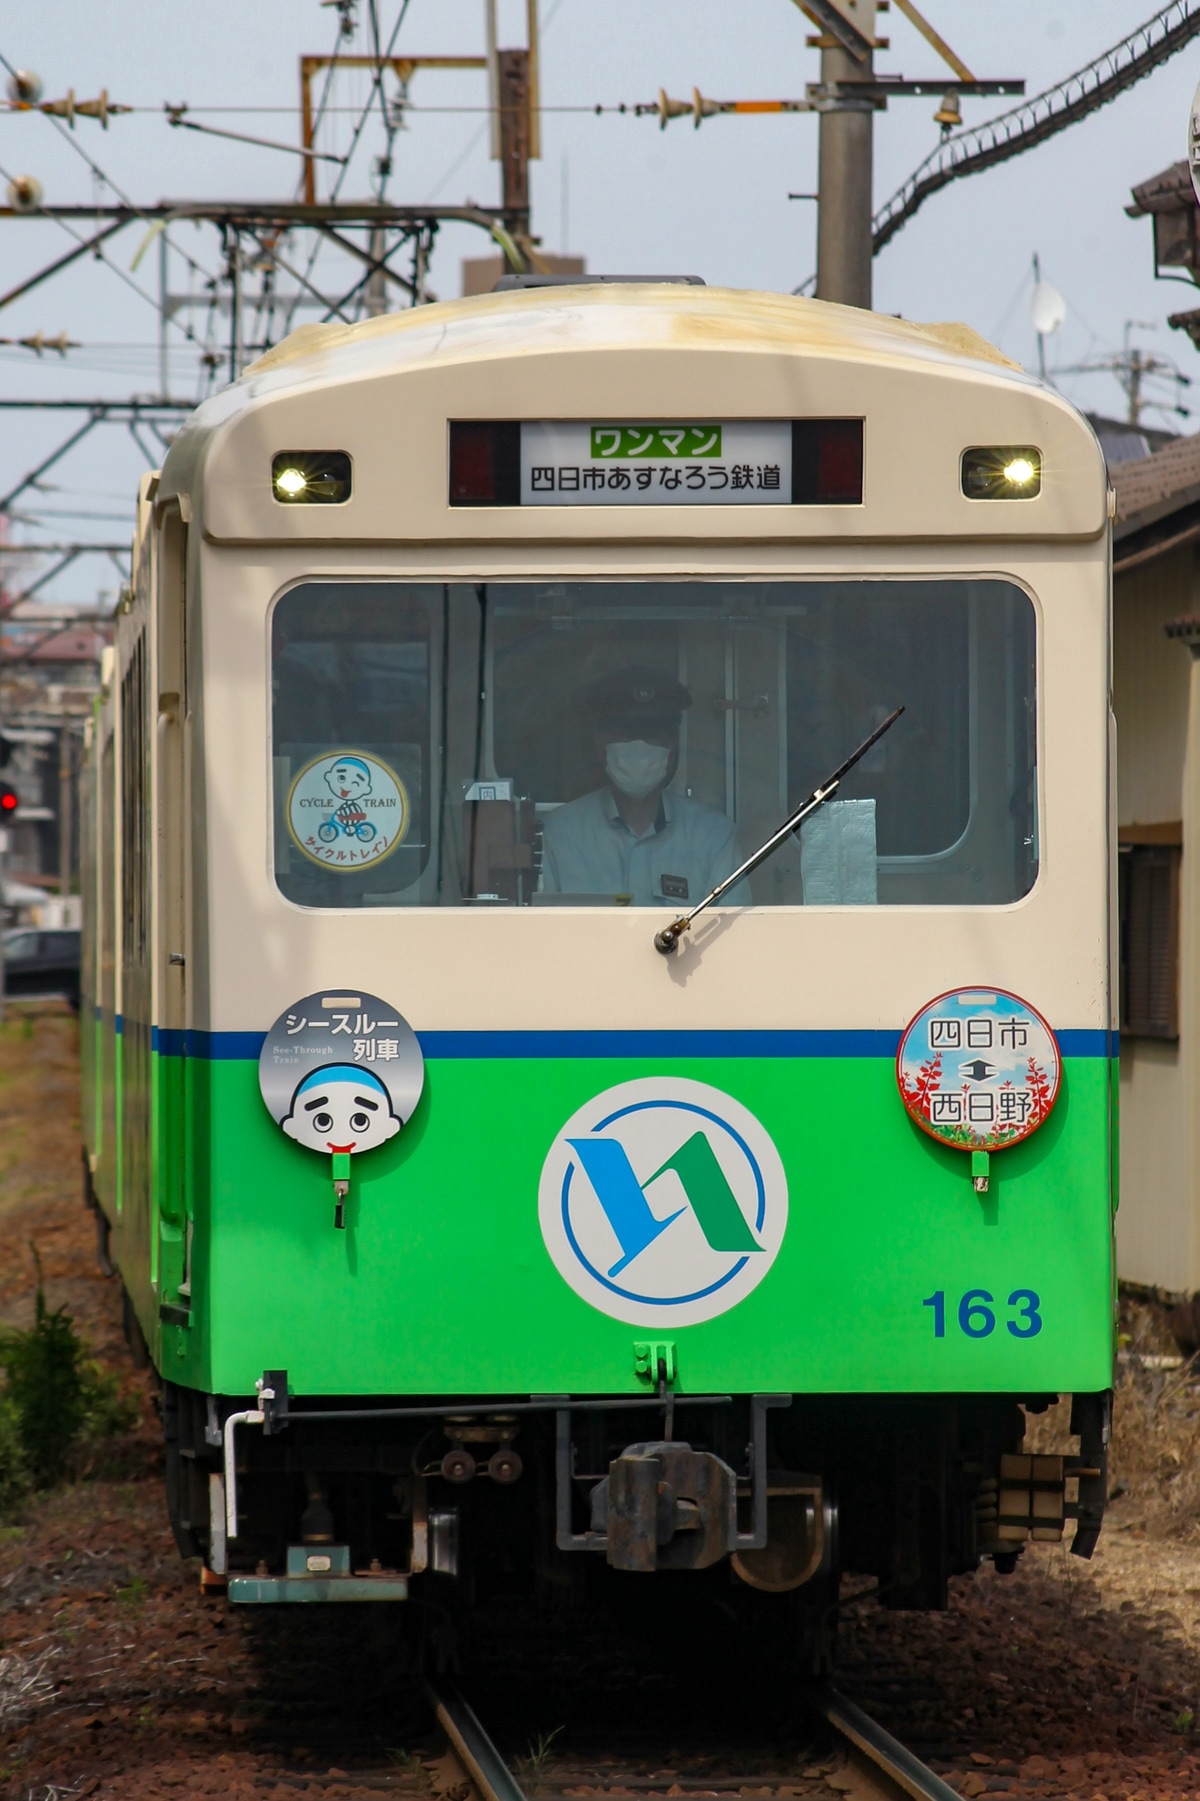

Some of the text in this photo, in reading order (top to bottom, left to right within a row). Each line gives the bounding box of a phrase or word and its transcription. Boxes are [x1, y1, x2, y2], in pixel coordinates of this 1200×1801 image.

[594, 428, 718, 456] ワンマン
[530, 464, 781, 491] 四日市あすなろう鉄道
[299, 798, 396, 808] CYCLE TRAIN
[286, 1013, 399, 1036] シースルー
[930, 1017, 1030, 1050] 四日市
[272, 1045, 334, 1055] See-Through
[273, 1055, 300, 1064] Train
[352, 1038, 400, 1061] 列車
[931, 1091, 1032, 1123] 西日野
[922, 1288, 1043, 1339] 163
